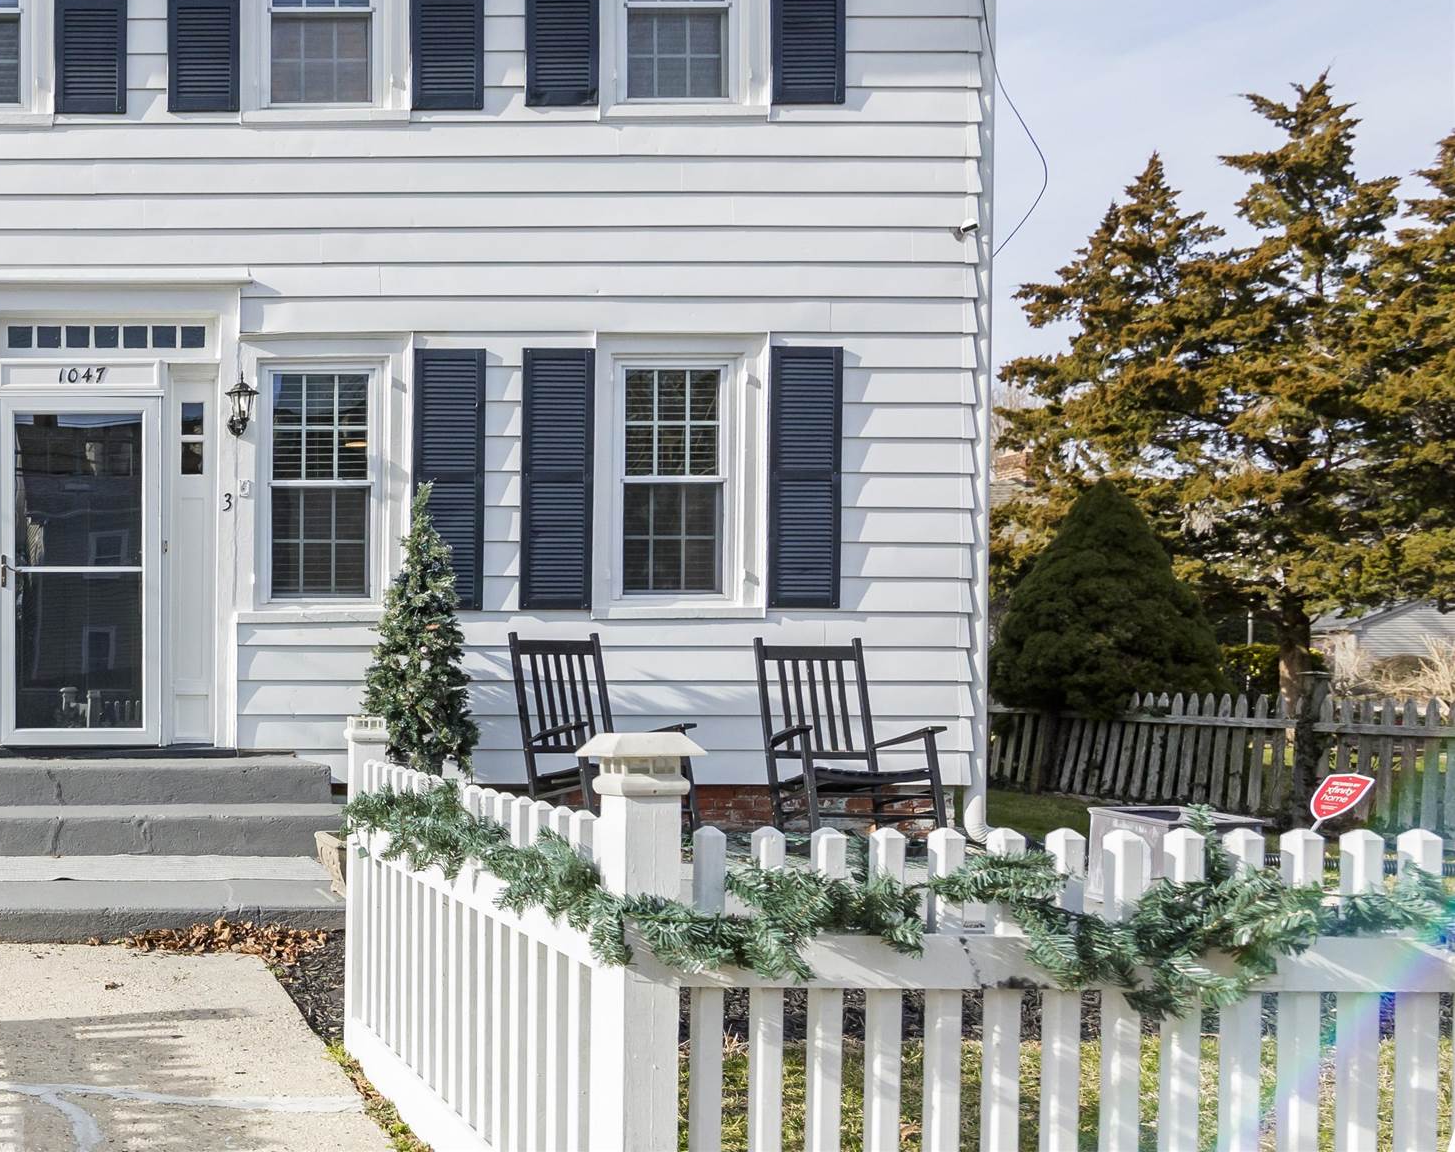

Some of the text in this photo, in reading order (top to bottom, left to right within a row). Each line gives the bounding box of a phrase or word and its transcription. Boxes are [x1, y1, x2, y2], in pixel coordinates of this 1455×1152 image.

[58, 366, 106, 384] 1047
[222, 492, 232, 512] 3
[1320, 793, 1348, 803] home
[1325, 786, 1356, 796] xfinity
